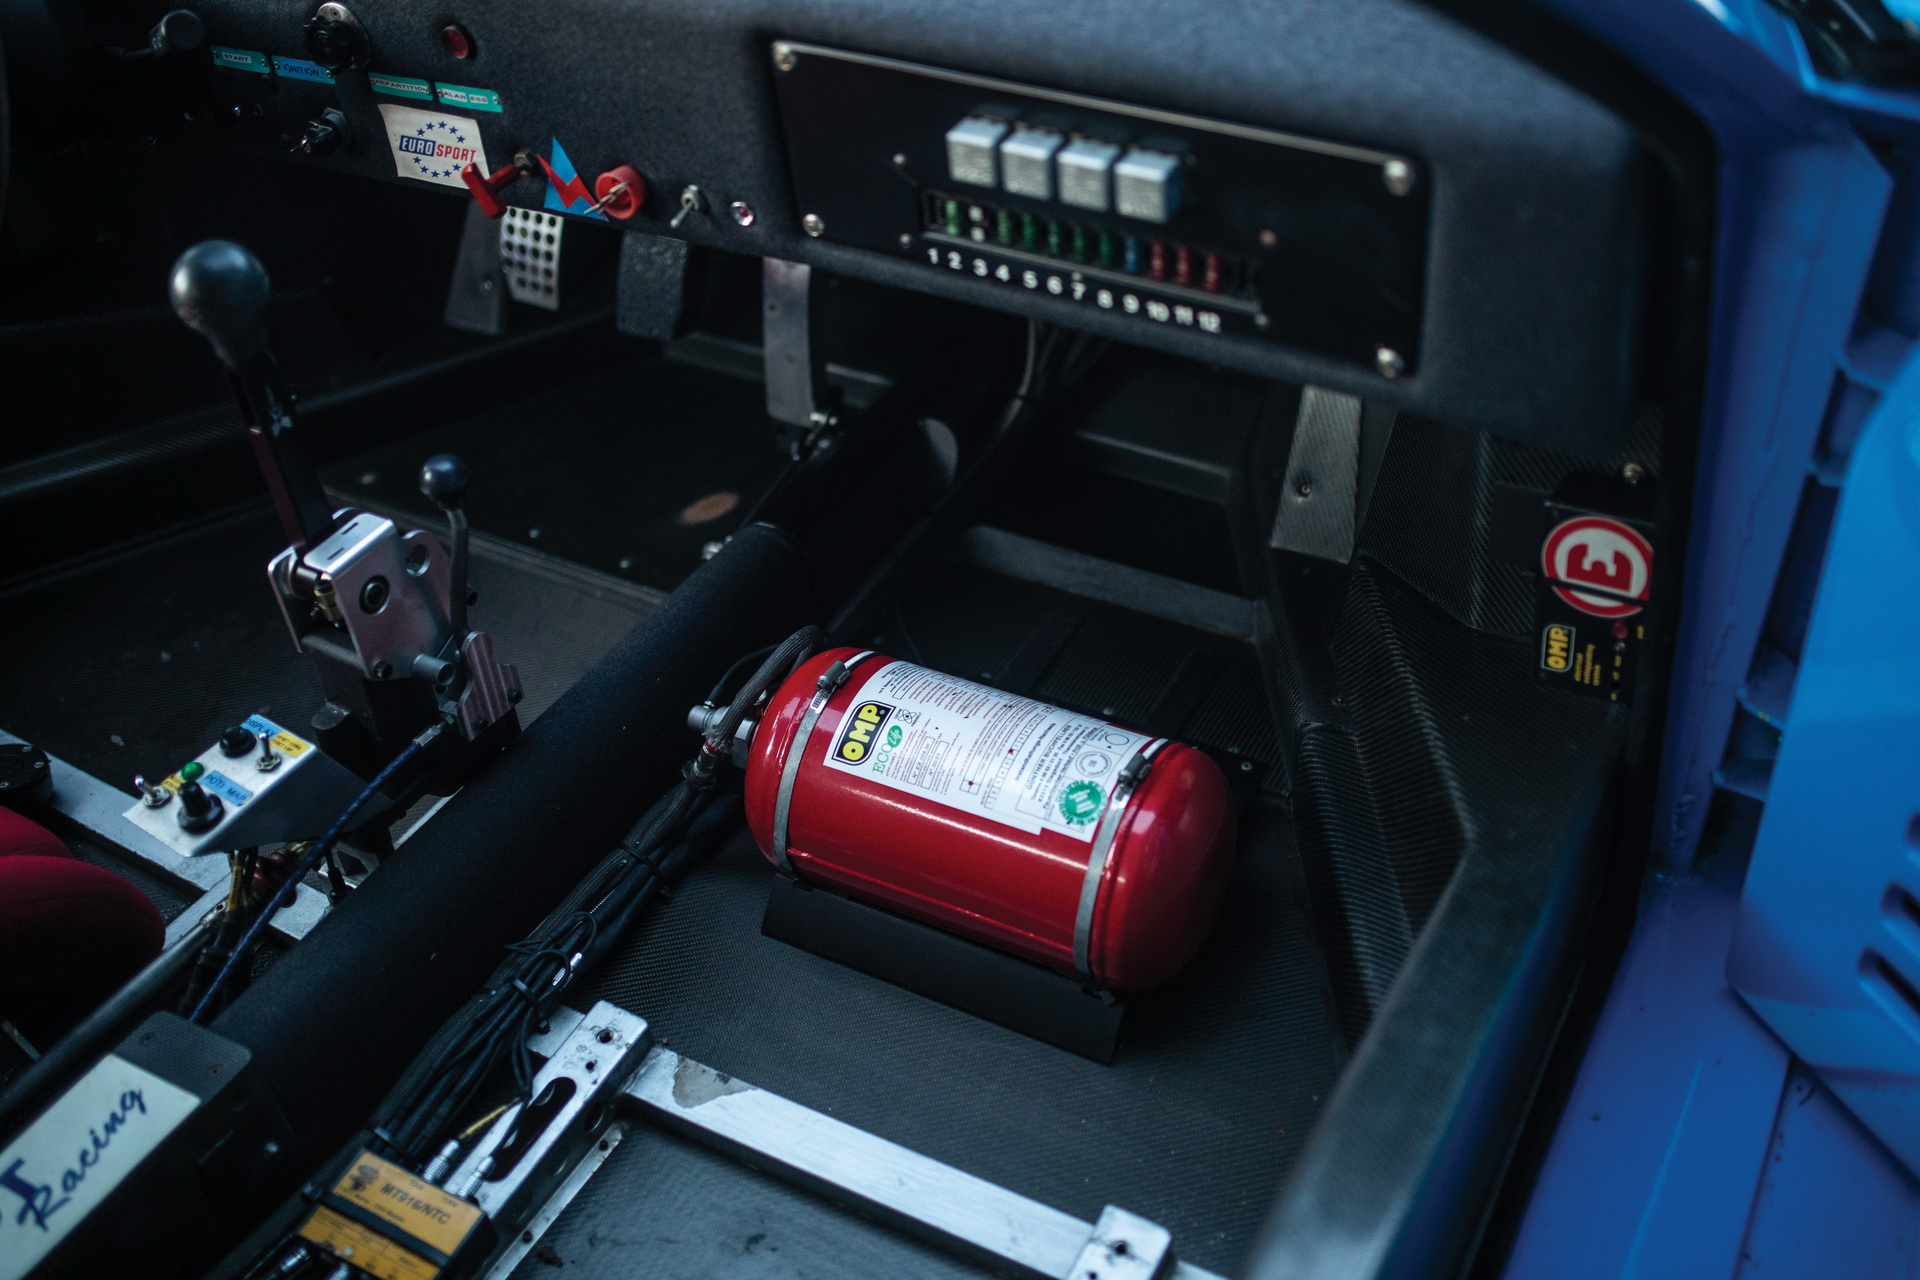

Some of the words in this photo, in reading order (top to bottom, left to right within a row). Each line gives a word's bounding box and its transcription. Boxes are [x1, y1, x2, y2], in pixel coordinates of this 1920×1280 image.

[224, 54, 250, 65] START
[282, 63, 321, 78] IGNITION
[374, 78, 429, 95] REPARTITION
[927, 248, 939, 265] 1
[948, 253, 962, 270] 2
[973, 259, 988, 276] 3
[995, 265, 1010, 282] 4
[1022, 270, 1038, 289] 5
[1047, 276, 1062, 294] 6
[1070, 282, 1086, 301] 7
[1097, 289, 1113, 309] 8
[1123, 294, 1140, 314] 9
[1146, 301, 1170, 322] 10
[1174, 305, 1194, 326] 11
[1199, 312, 1221, 333] 12
[1566, 543, 1633, 591] E
[1546, 627, 1569, 669] OMP
[244, 717, 277, 738] DISPLAY
[841, 703, 882, 761] OMP
[872, 741, 893, 774] ECO
[889, 728, 901, 744] Life
[206, 774, 224, 788] POTI
[227, 786, 246, 802] MAP
[16, 1087, 147, 1231] Racing
[379, 1183, 452, 1225] MT916/NTC
